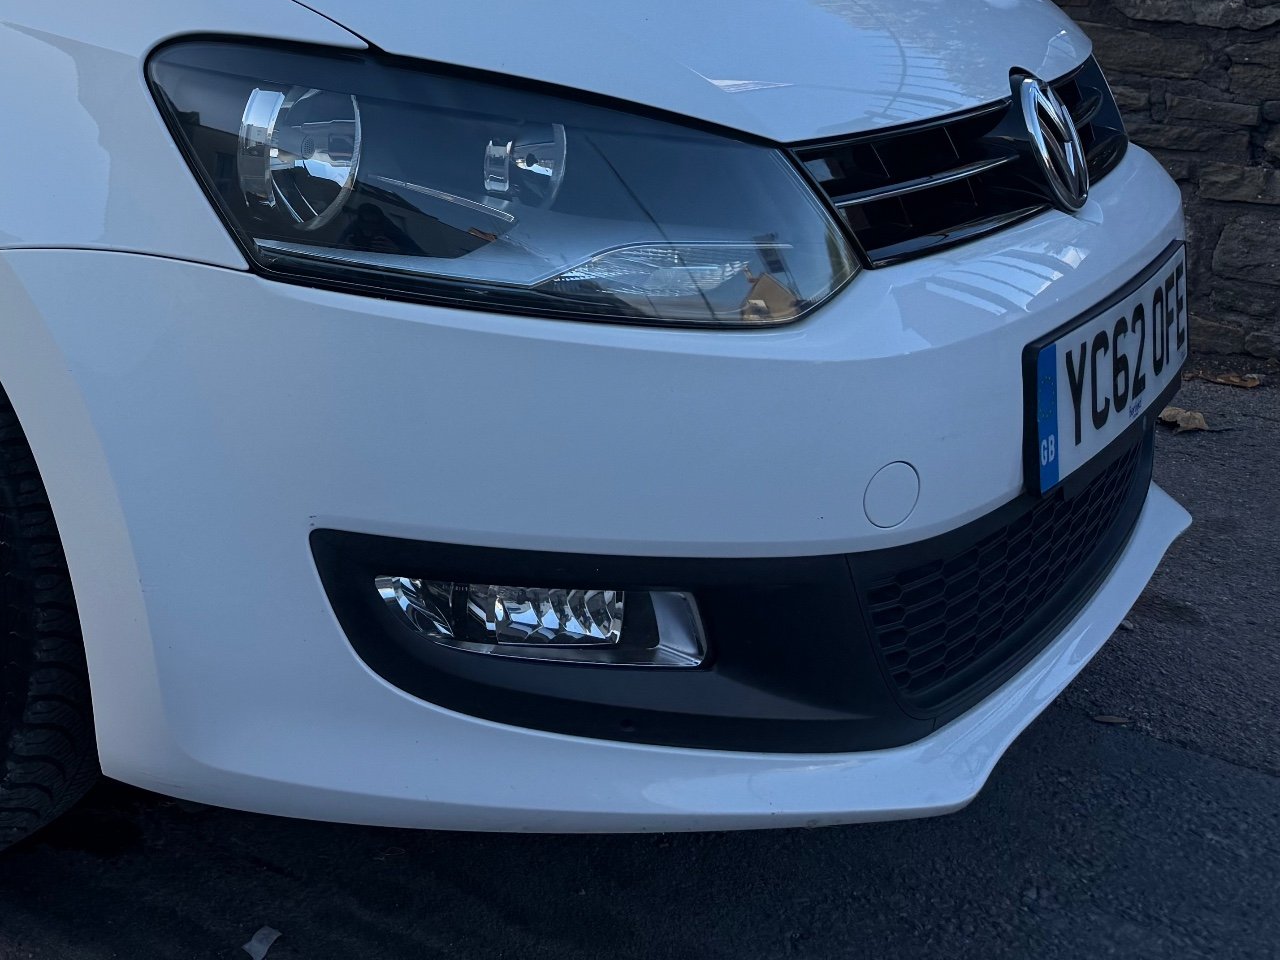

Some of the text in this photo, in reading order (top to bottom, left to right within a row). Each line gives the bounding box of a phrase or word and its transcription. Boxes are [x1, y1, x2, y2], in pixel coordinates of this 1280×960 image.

[1065, 261, 1186, 446] YC62 OFE
[1040, 434, 1056, 467] GB
